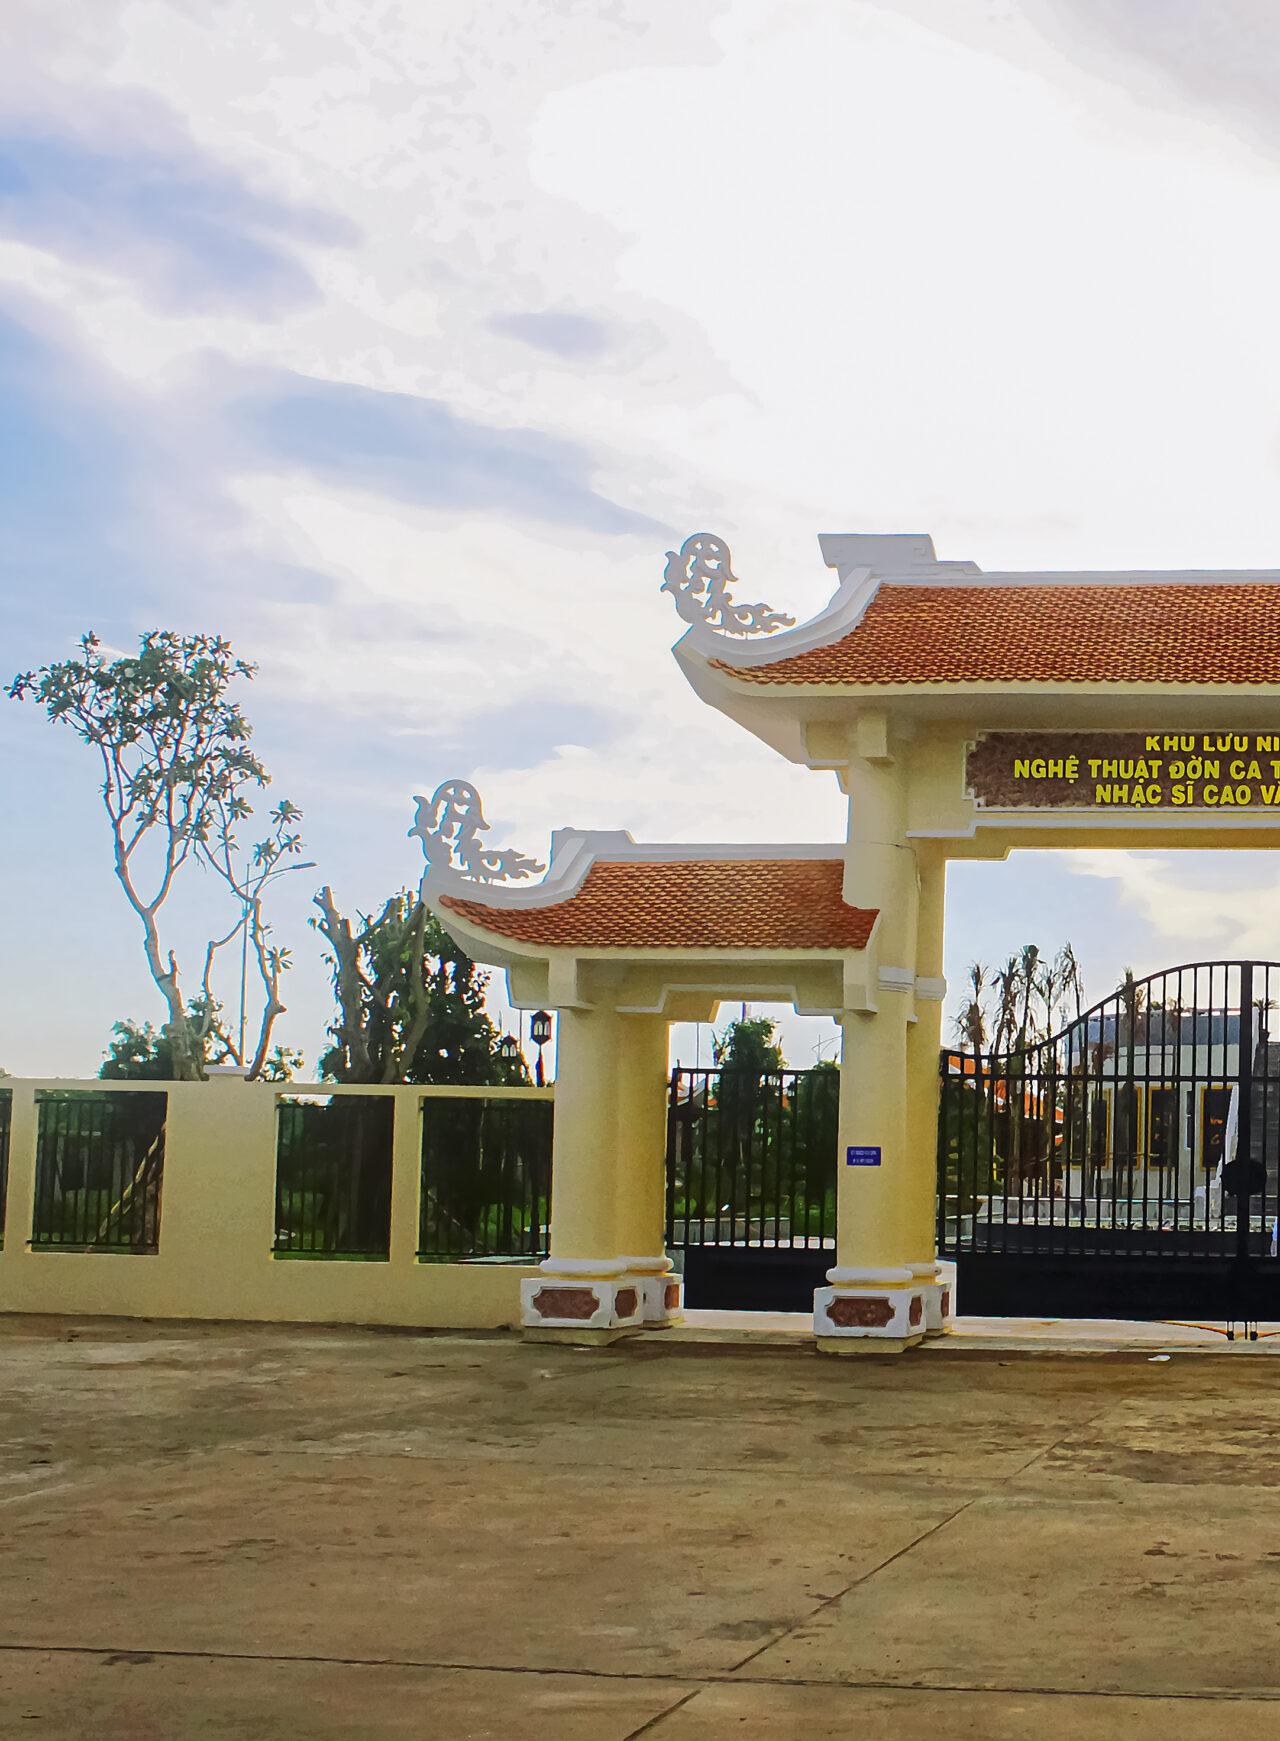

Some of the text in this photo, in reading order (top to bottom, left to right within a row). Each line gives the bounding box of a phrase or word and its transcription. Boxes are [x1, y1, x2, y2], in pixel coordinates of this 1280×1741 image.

[1146, 736, 1195, 752] KHU
[1203, 733, 1249, 752] LƯU
[1014, 755, 1080, 783] NGHỆ
[1168, 754, 1221, 780] ĐỜN
[1229, 760, 1262, 780] CA
[1095, 784, 1162, 808] NHẠC
[1171, 780, 1195, 804] SĨ
[1203, 784, 1251, 805] CAO
